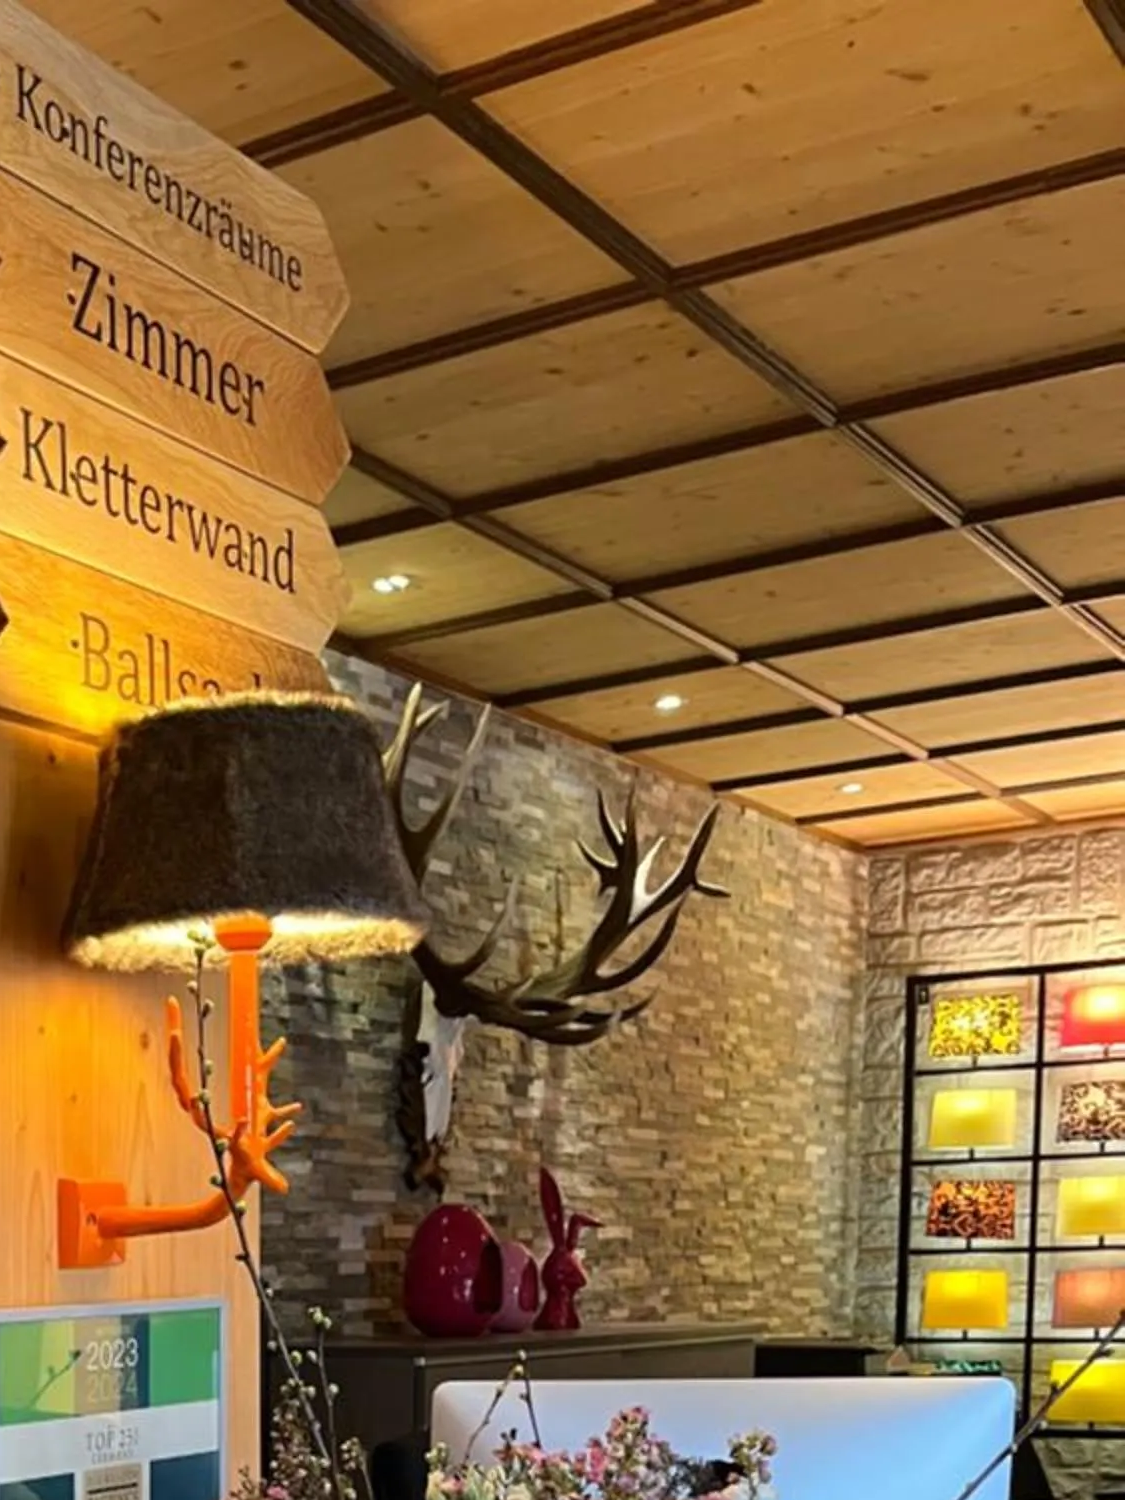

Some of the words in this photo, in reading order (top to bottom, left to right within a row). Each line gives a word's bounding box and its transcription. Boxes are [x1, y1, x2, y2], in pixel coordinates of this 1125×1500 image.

[15, 66, 304, 294] Konferenzräume
[71, 252, 266, 428] Zimmer
[19, 408, 298, 595] Kletterwand
[81, 611, 261, 706] Balls
[85, 1337, 139, 1371] 2023
